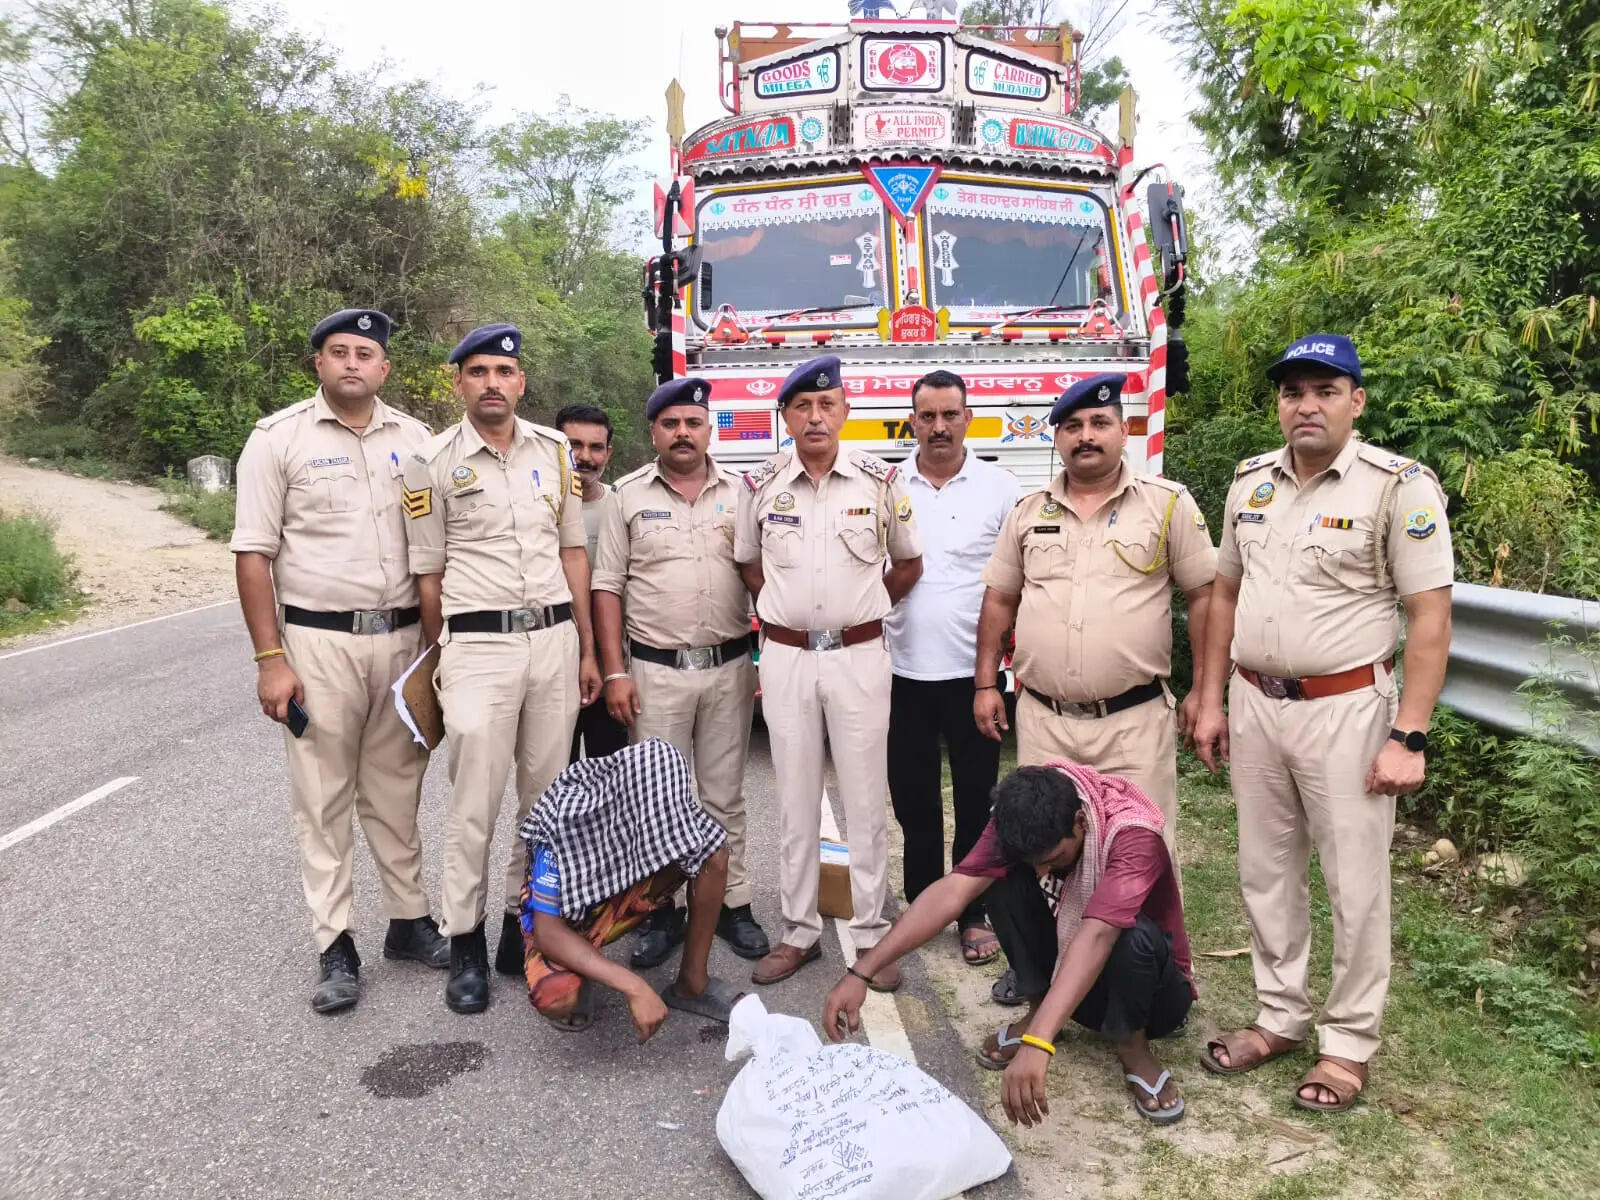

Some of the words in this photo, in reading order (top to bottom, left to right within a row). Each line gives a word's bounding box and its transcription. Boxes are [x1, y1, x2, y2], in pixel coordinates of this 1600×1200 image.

[762, 61, 811, 82] GOODS
[994, 63, 1043, 85] CARRIER
[762, 80, 812, 94] MILEGA
[893, 116, 912, 126] ALL
[914, 116, 941, 126] INDIA
[705, 122, 790, 154] SATNAM
[896, 128, 937, 138] PERMIT
[863, 237, 874, 270] SATNAM
[1286, 342, 1336, 360] POLICE
[740, 431, 772, 440] USA
[883, 422, 916, 439] TA
